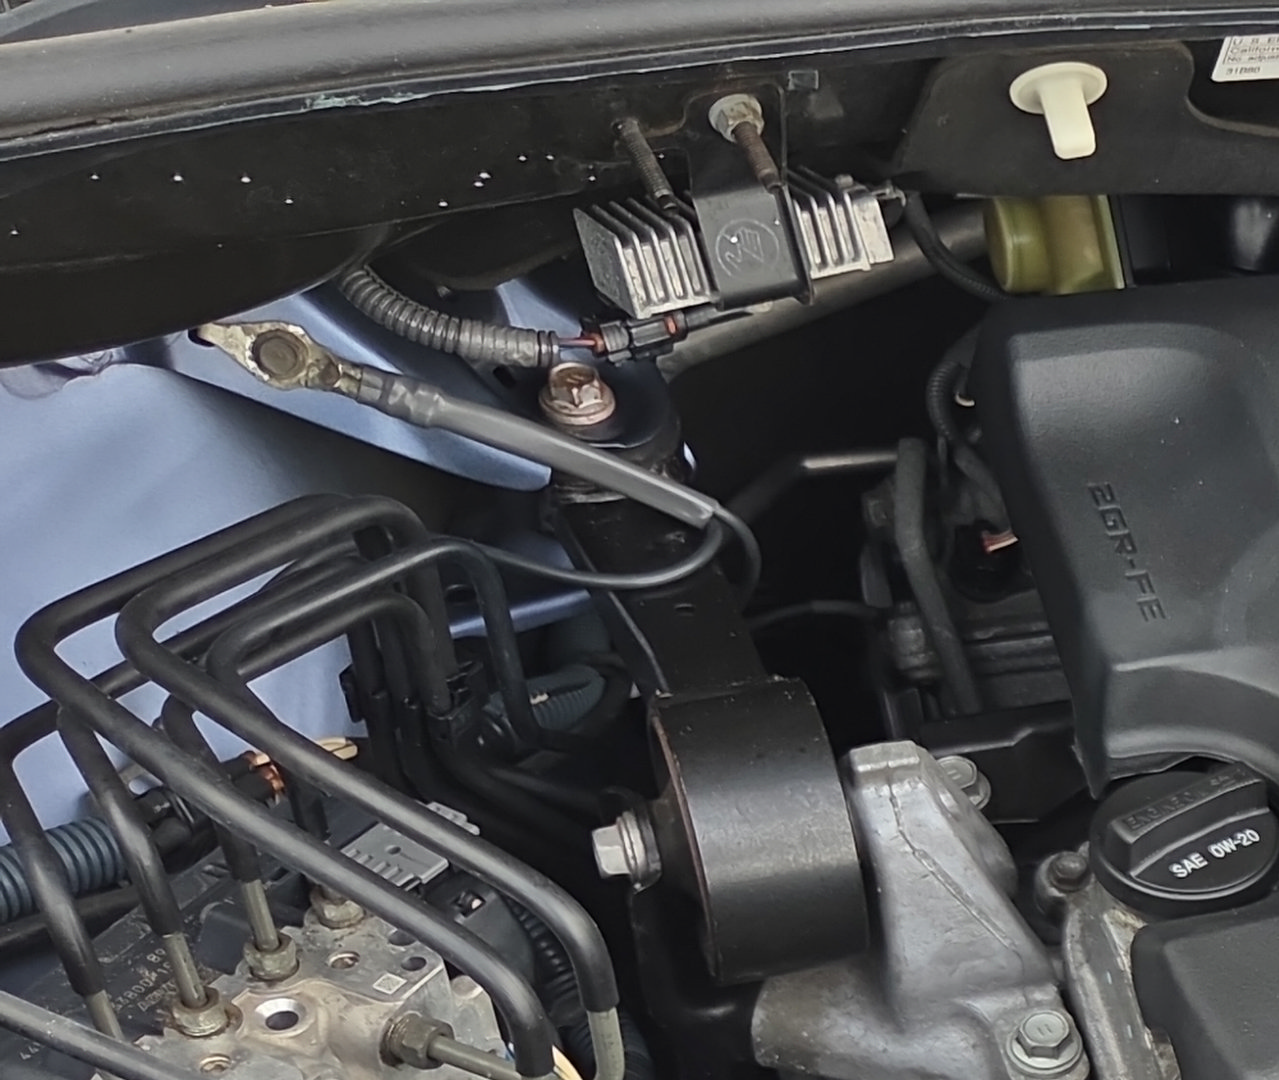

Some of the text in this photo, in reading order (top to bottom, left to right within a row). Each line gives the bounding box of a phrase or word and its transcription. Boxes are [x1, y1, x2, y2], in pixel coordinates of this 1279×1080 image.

[1087, 481, 1167, 623] 2GR-FE
[1169, 828, 1260, 879] SAE 0W-20
